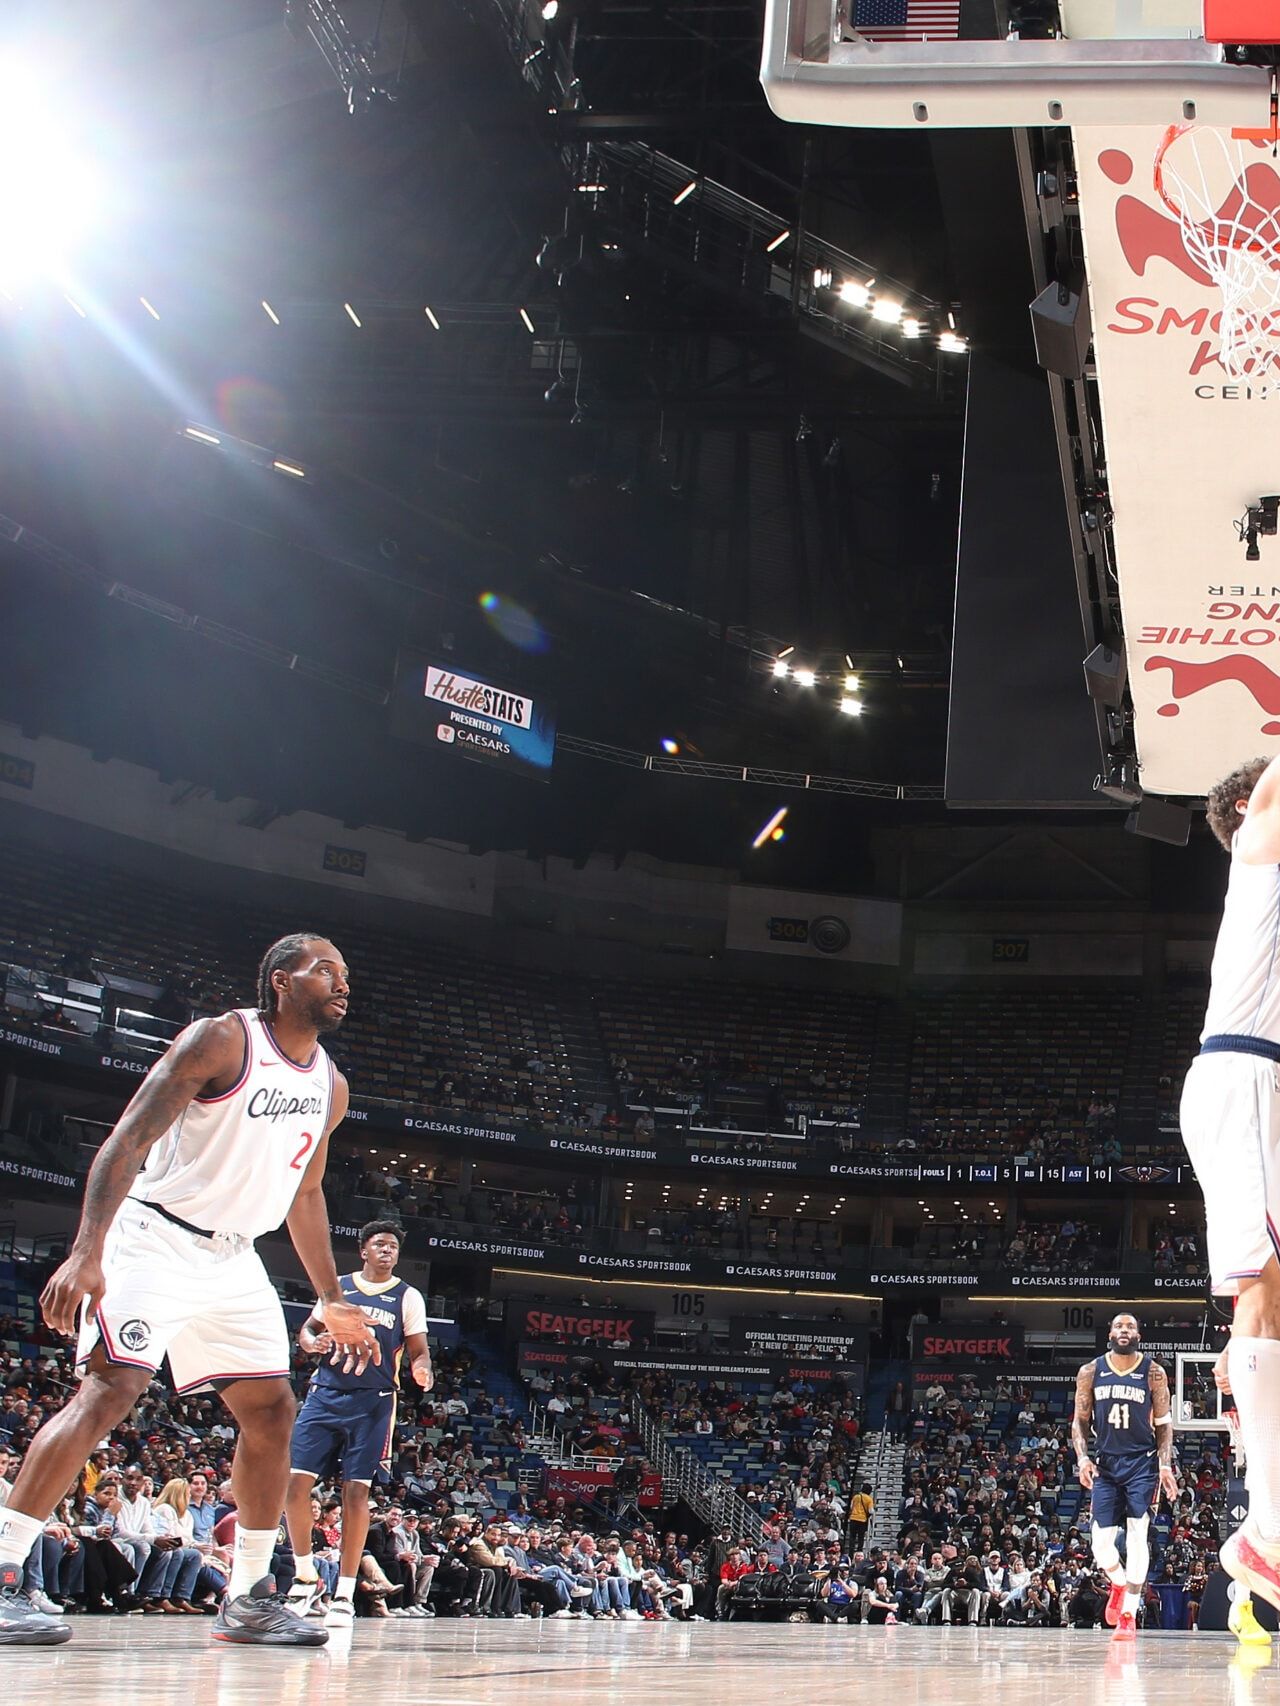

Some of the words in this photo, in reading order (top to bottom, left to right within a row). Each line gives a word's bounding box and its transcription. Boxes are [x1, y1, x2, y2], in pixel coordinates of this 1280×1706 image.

[450, 711, 492, 732] PRESENTED
[492, 725, 503, 736] BY
[457, 730, 511, 754] CAESARS
[326, 848, 364, 873] 305
[994, 943, 1026, 959] 307
[6, 1031, 61, 1056] SPORTSBOOK
[113, 1058, 149, 1074] CAESA
[247, 1087, 322, 1124] Clippers
[415, 1119, 462, 1134] CAESARS
[463, 1127, 516, 1142] SPORTSBOOK
[289, 1131, 313, 1170] 2
[559, 1140, 603, 1155] CAESARS
[604, 1146, 657, 1160] SPORTSBOOK
[700, 1155, 745, 1166] CAESARS
[746, 1158, 797, 1170] SPORTSBOOK
[839, 1165, 882, 1176] CAESARS
[20, 1166, 76, 1188] SPORTSBOOK
[922, 1168, 945, 1178] FOULS
[956, 1169, 962, 1178] 1
[1003, 1169, 1010, 1179] 5
[1024, 1170, 1035, 1178] RB
[1046, 1169, 1059, 1179] 15
[1068, 1170, 1082, 1178] AST
[1094, 1169, 1106, 1179] 10
[439, 1238, 488, 1253] CAESARS
[490, 1244, 545, 1259] SPORTSBOOK
[588, 1254, 635, 1268] CAESARS
[637, 1259, 691, 1272] SPORTSBOOK
[736, 1266, 782, 1278] CAESARS
[784, 1269, 837, 1281] SPORTSBOOK
[880, 1274, 925, 1284] CAESARS
[926, 1275, 979, 1285] SPORTSBOOK
[1021, 1276, 1067, 1286] CAESARS
[1068, 1277, 1121, 1287] SPORTSBOOK
[672, 1293, 705, 1316] 105
[526, 1310, 635, 1342] SEATGEEK
[1062, 1306, 1094, 1329] 106
[745, 1331, 776, 1341] OFFICIAL
[776, 1333, 813, 1343] TICKETING
[813, 1335, 844, 1345] PARTNER
[844, 1336, 855, 1345] OF
[751, 1340, 765, 1349] TE
[765, 1341, 781, 1350] NEW
[922, 1336, 1012, 1358] SEATGEEK
[1138, 1342, 1173, 1351] TICKETING
[524, 1351, 568, 1364] SEATGEEK
[613, 1360, 637, 1369] OFFICIAL
[637, 1361, 665, 1370] TICKETING
[665, 1362, 690, 1371] PARTNER
[690, 1363, 698, 1371] OF
[698, 1364, 707, 1372] THE
[707, 1365, 720, 1373] NEW
[721, 1366, 744, 1374] ORLEANS
[744, 1366, 770, 1375] PELICANS
[788, 1368, 832, 1380] SEATGEEK
[915, 1372, 955, 1383] SEATGEEK
[1094, 1386, 1111, 1401] NEW
[1111, 1384, 1147, 1404] ORLEANS
[1107, 1403, 1131, 1430] 41
